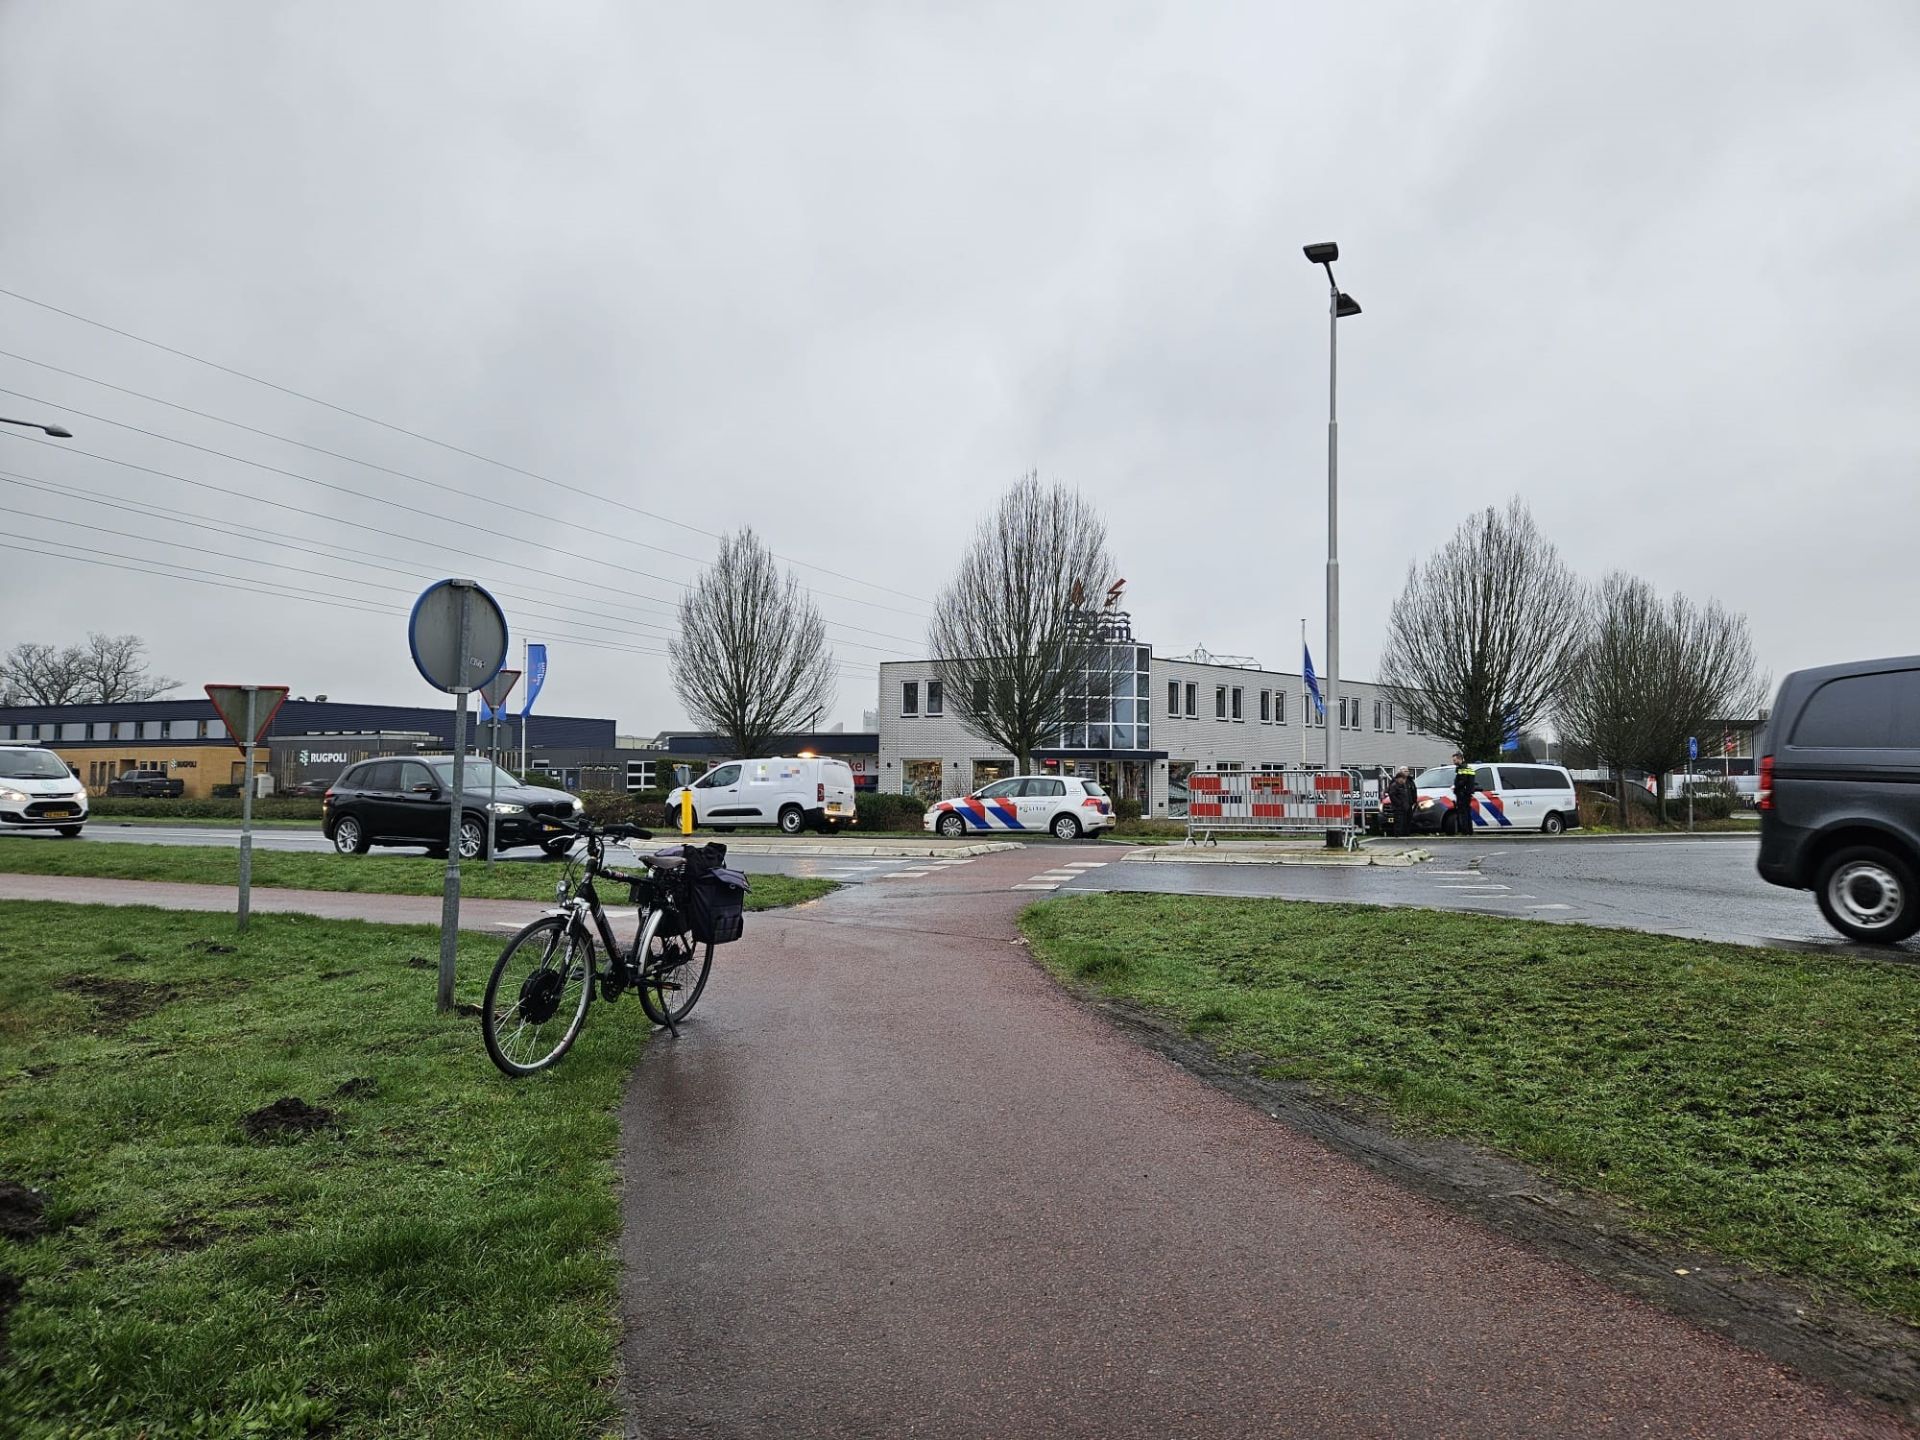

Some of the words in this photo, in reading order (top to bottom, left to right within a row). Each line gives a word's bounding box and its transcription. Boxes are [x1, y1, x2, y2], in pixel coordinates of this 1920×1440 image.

[311, 752, 346, 762] RUGPOLI
[848, 760, 866, 772] kel
[1514, 798, 1532, 806] POLITIE
[1020, 804, 1046, 812] POLITIE
